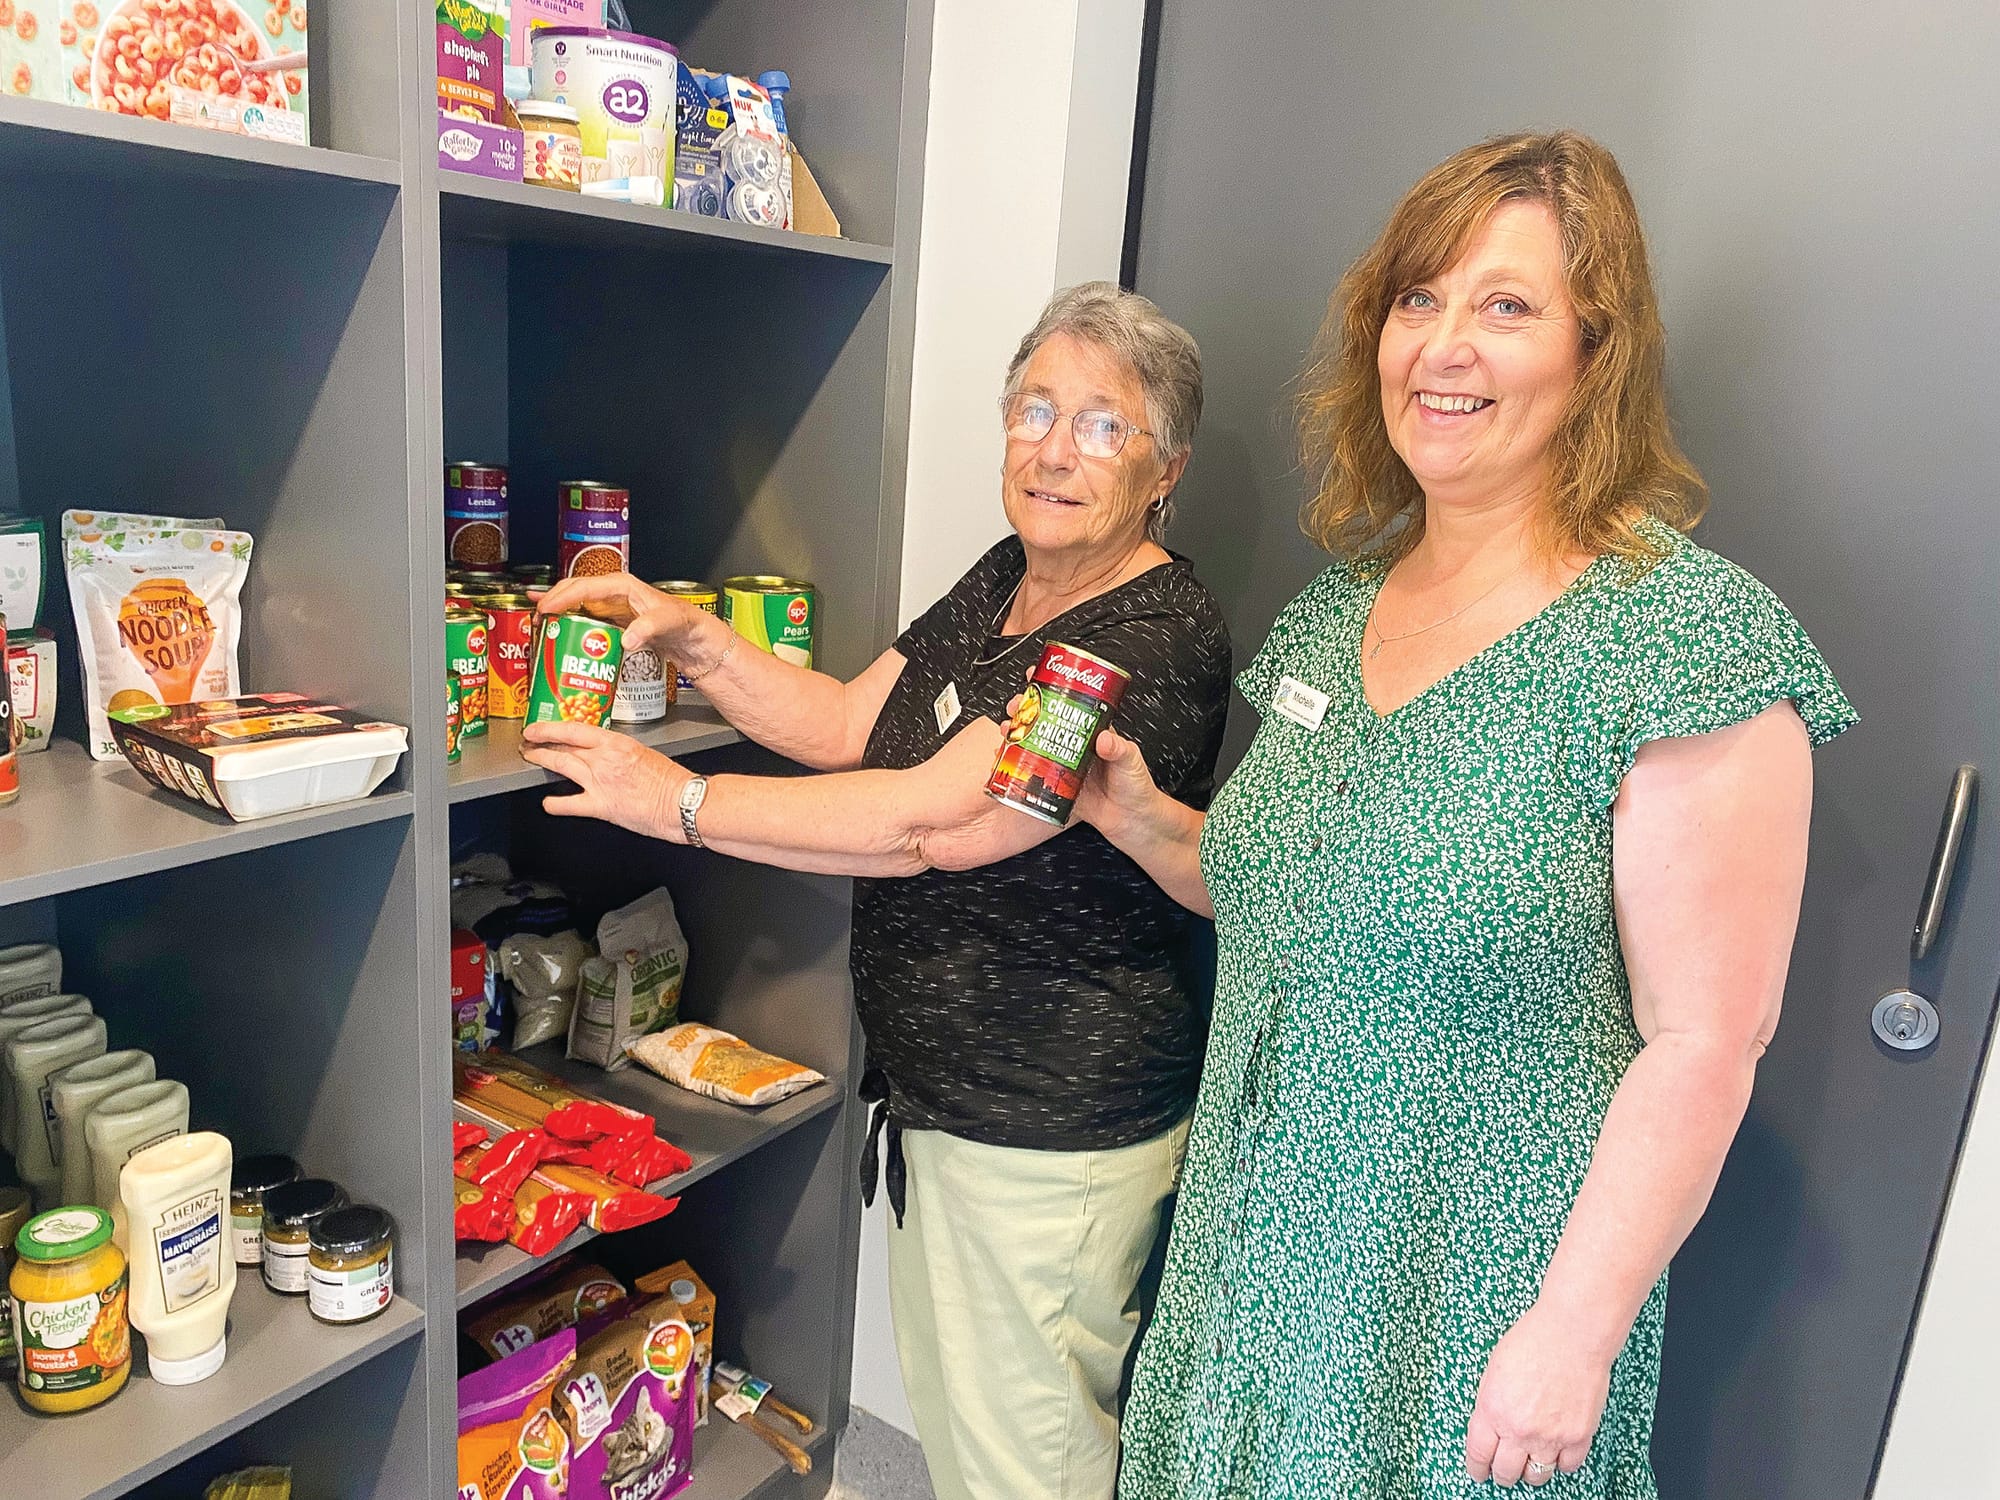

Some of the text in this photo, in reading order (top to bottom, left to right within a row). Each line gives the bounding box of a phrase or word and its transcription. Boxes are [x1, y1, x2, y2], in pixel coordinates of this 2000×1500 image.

[585, 44, 617, 57] Smart
[621, 49, 662, 68] Nutrition
[609, 86, 645, 116] a2
[499, 138, 518, 152] 10+
[467, 497, 497, 507] Lentils
[587, 519, 618, 530] Lentils
[137, 594, 189, 617] CHICKEN
[790, 606, 806, 619] spc
[117, 606, 217, 648] NOODLE
[783, 625, 810, 637] Pears
[143, 635, 205, 675] SOUP
[585, 637, 608, 652] spc
[571, 656, 617, 683] BEANS
[1045, 654, 1107, 692] Campbell's
[1046, 699, 1097, 730] CHUNKY
[1037, 720, 1086, 753] CHICKEN
[1037, 739, 1079, 763] VEGETABLE
[172, 1195, 211, 1221] HEINZ
[163, 1223, 218, 1260] MAYONNAISE
[344, 1245, 362, 1254] OPEN
[29, 1299, 92, 1329] Chicken
[44, 1312, 90, 1336] Tonight
[32, 1350, 65, 1364] honey
[32, 1357, 78, 1370] mustard
[566, 1375, 596, 1404] 1+
